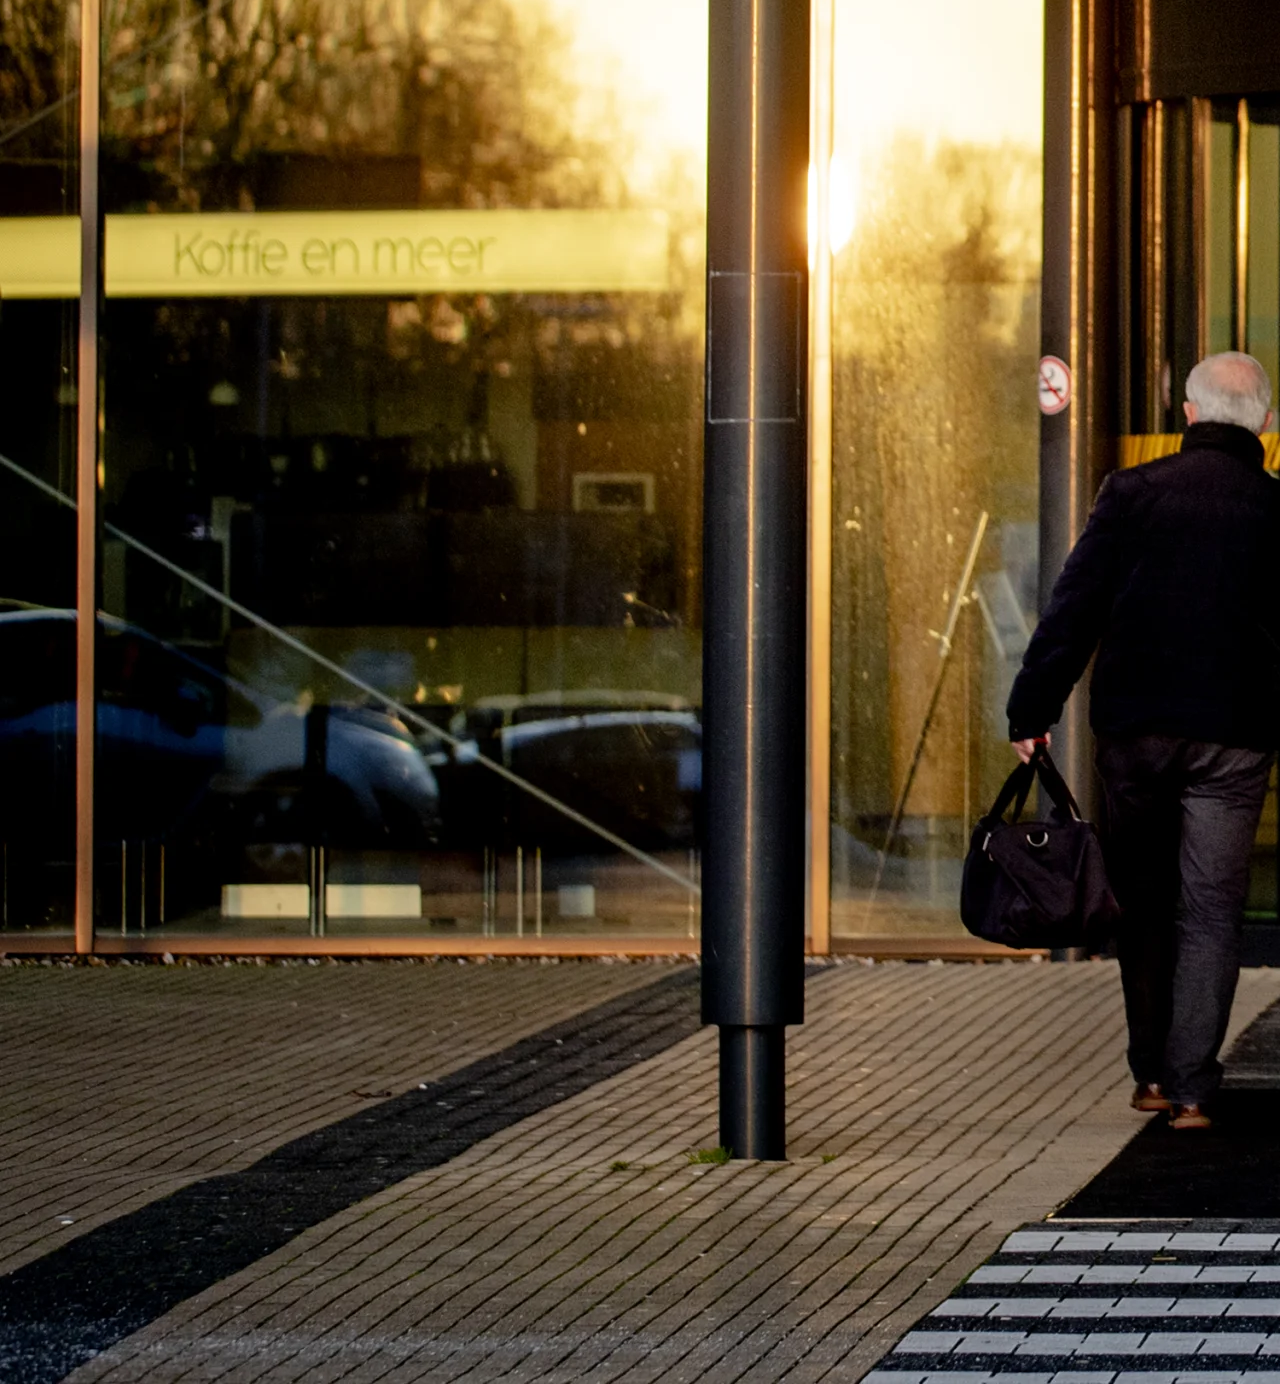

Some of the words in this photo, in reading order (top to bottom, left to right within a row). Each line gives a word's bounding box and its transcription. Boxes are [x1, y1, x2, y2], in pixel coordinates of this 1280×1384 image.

[173, 228, 288, 278] Koffie
[302, 236, 360, 277] en
[372, 235, 497, 276] meer
